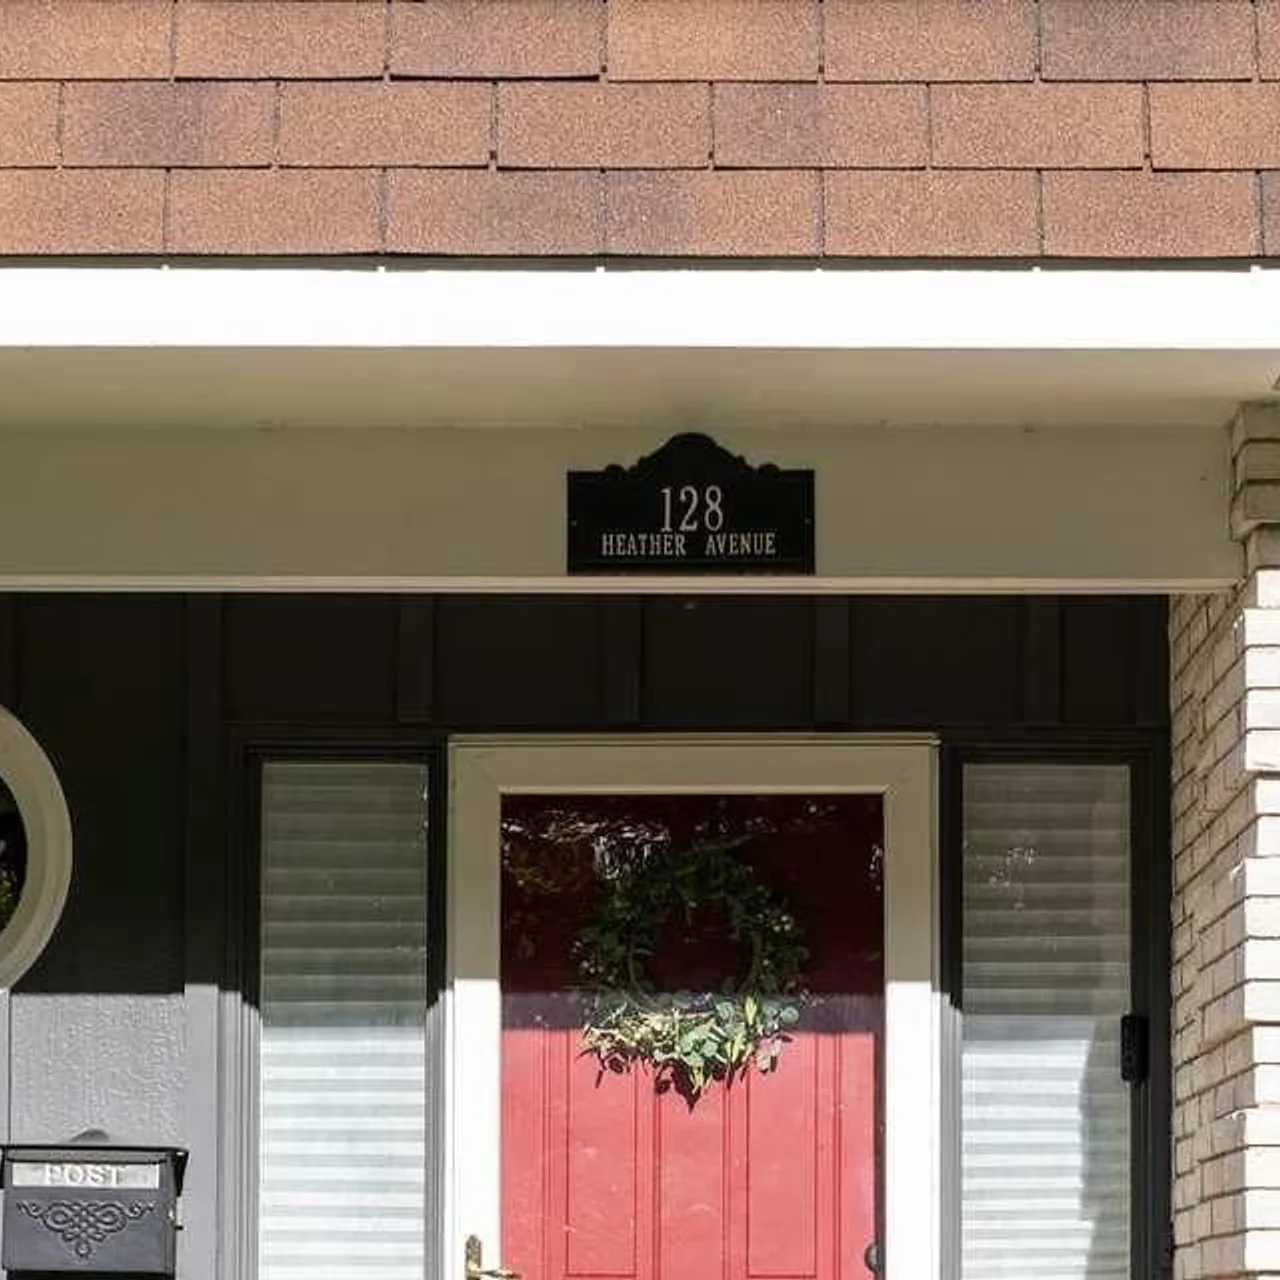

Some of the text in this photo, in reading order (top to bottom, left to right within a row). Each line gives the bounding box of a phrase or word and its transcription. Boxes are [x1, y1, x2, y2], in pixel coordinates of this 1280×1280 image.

[660, 485, 724, 532] 128
[602, 533, 777, 556] HEATHER AVENUE
[46, 1164, 124, 1186] POST
